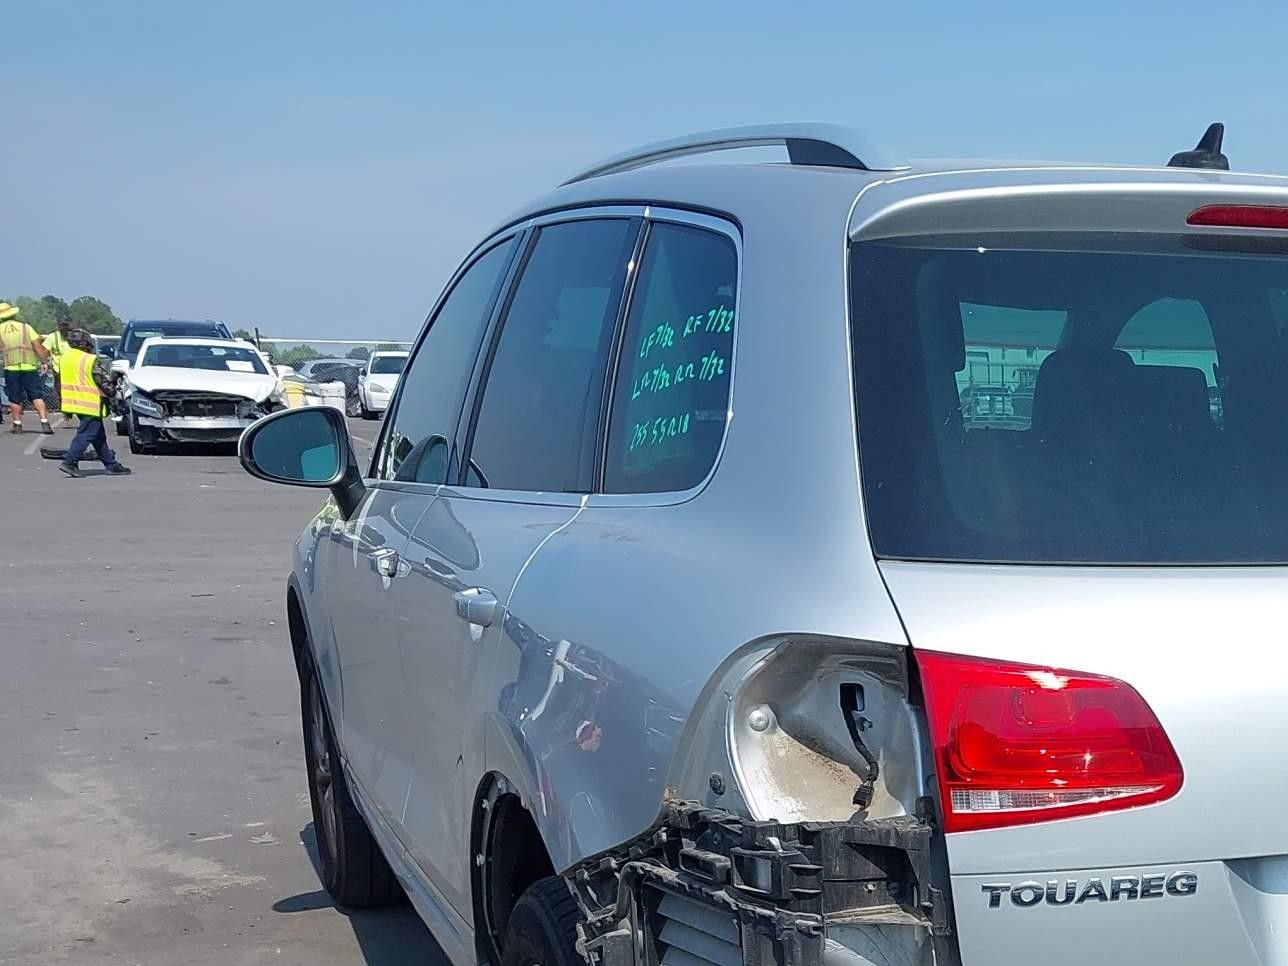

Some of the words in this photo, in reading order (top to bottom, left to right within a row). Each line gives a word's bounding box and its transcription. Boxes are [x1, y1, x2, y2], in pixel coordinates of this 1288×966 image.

[683, 315, 704, 338] RF
[705, 304, 734, 333] 7/32
[699, 350, 725, 382] 7/32
[981, 870, 1199, 909] TOUAREG
